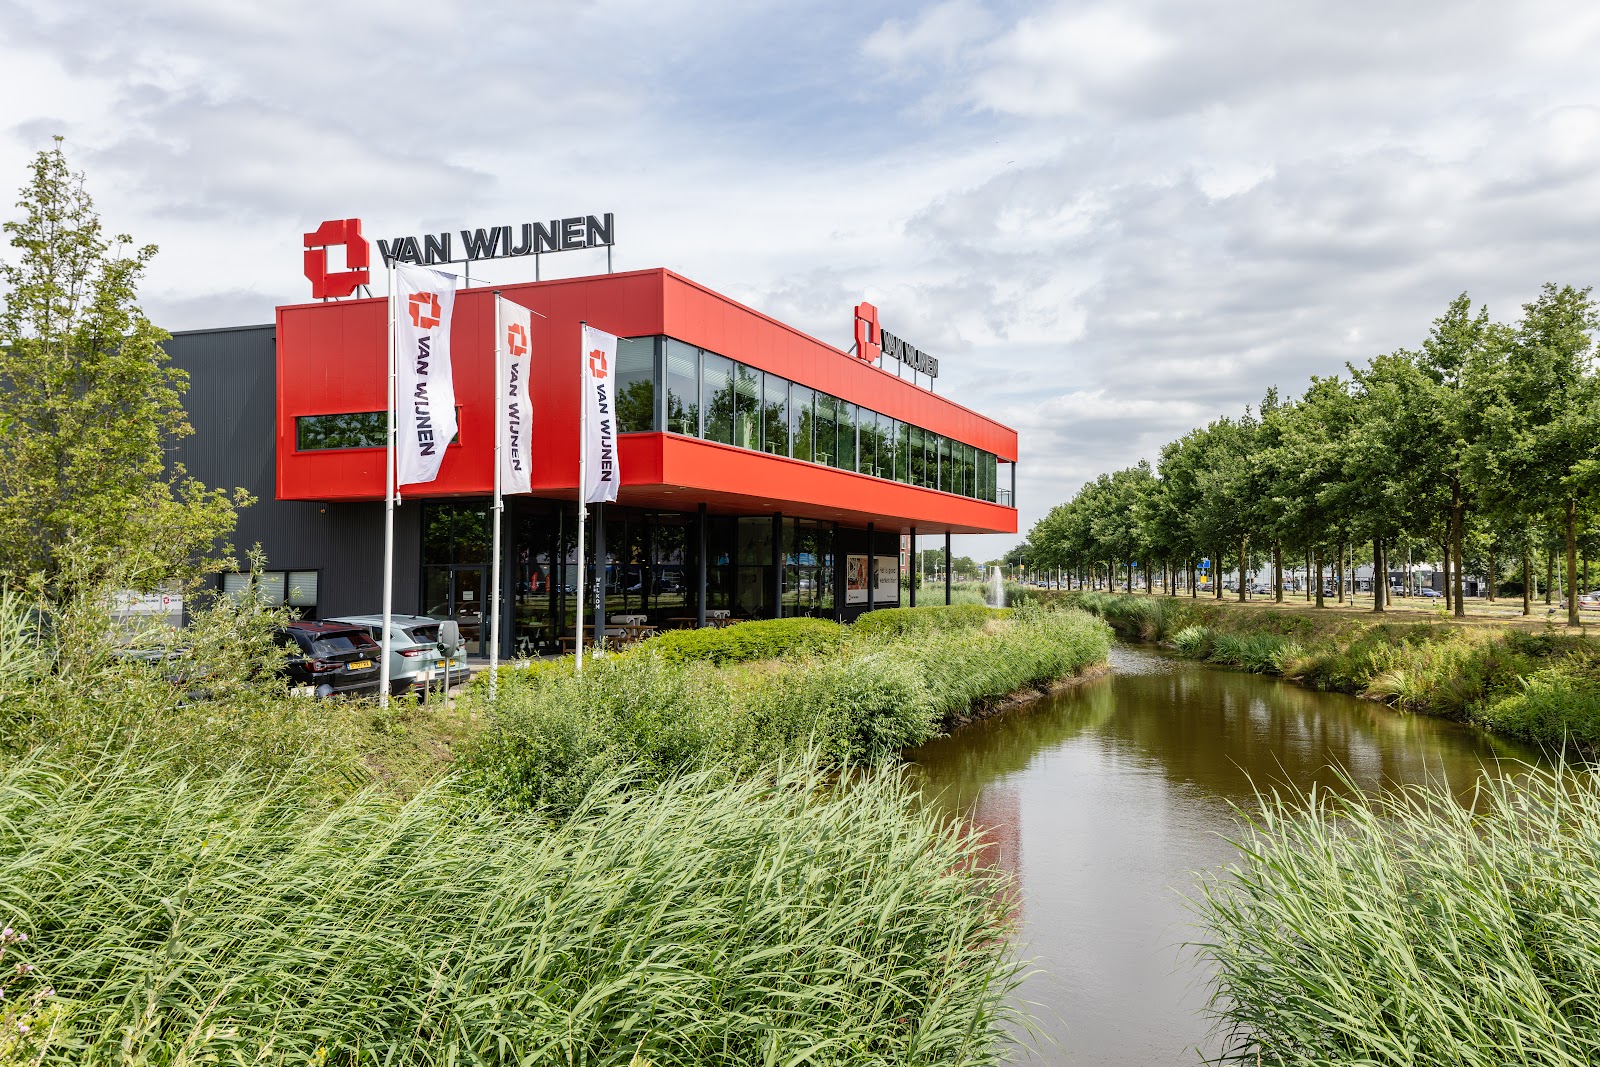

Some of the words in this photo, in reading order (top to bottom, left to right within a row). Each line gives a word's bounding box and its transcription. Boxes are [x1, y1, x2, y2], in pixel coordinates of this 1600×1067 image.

[376, 232, 451, 269] VAN
[460, 213, 615, 261] WIJNEN
[415, 335, 431, 376] VAN
[508, 362, 520, 397] VAN
[880, 328, 903, 361] VAN
[902, 341, 938, 378] WIJNEN
[413, 382, 436, 457] WIJNEN
[596, 383, 609, 415] VAN
[508, 402, 522, 472] WIJNEN
[600, 419, 613, 482] WIJNEN
